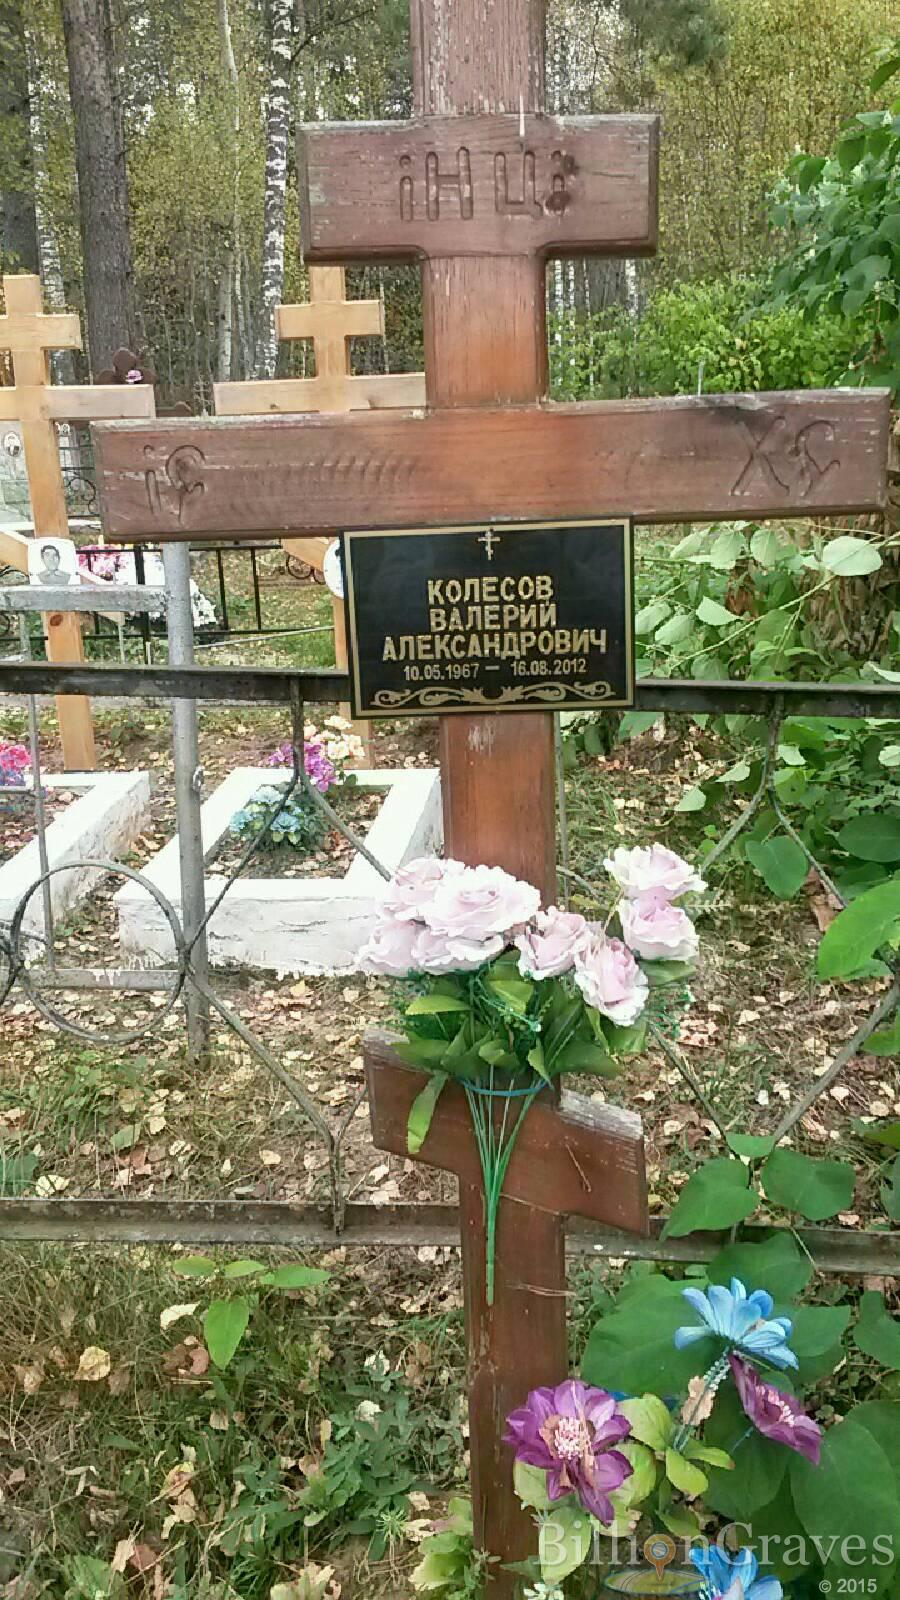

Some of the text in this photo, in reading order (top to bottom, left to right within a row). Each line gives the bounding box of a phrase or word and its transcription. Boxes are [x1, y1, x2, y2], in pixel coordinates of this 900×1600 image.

[427, 575, 554, 605] КОЛЕСОВ
[429, 601, 557, 632] ВАЛЕРИЙ
[382, 629, 607, 661] АЛЕКСАНДРОВИЧ
[403, 663, 479, 681] 10.05.1967
[510, 658, 587, 677] 16.08.2012
